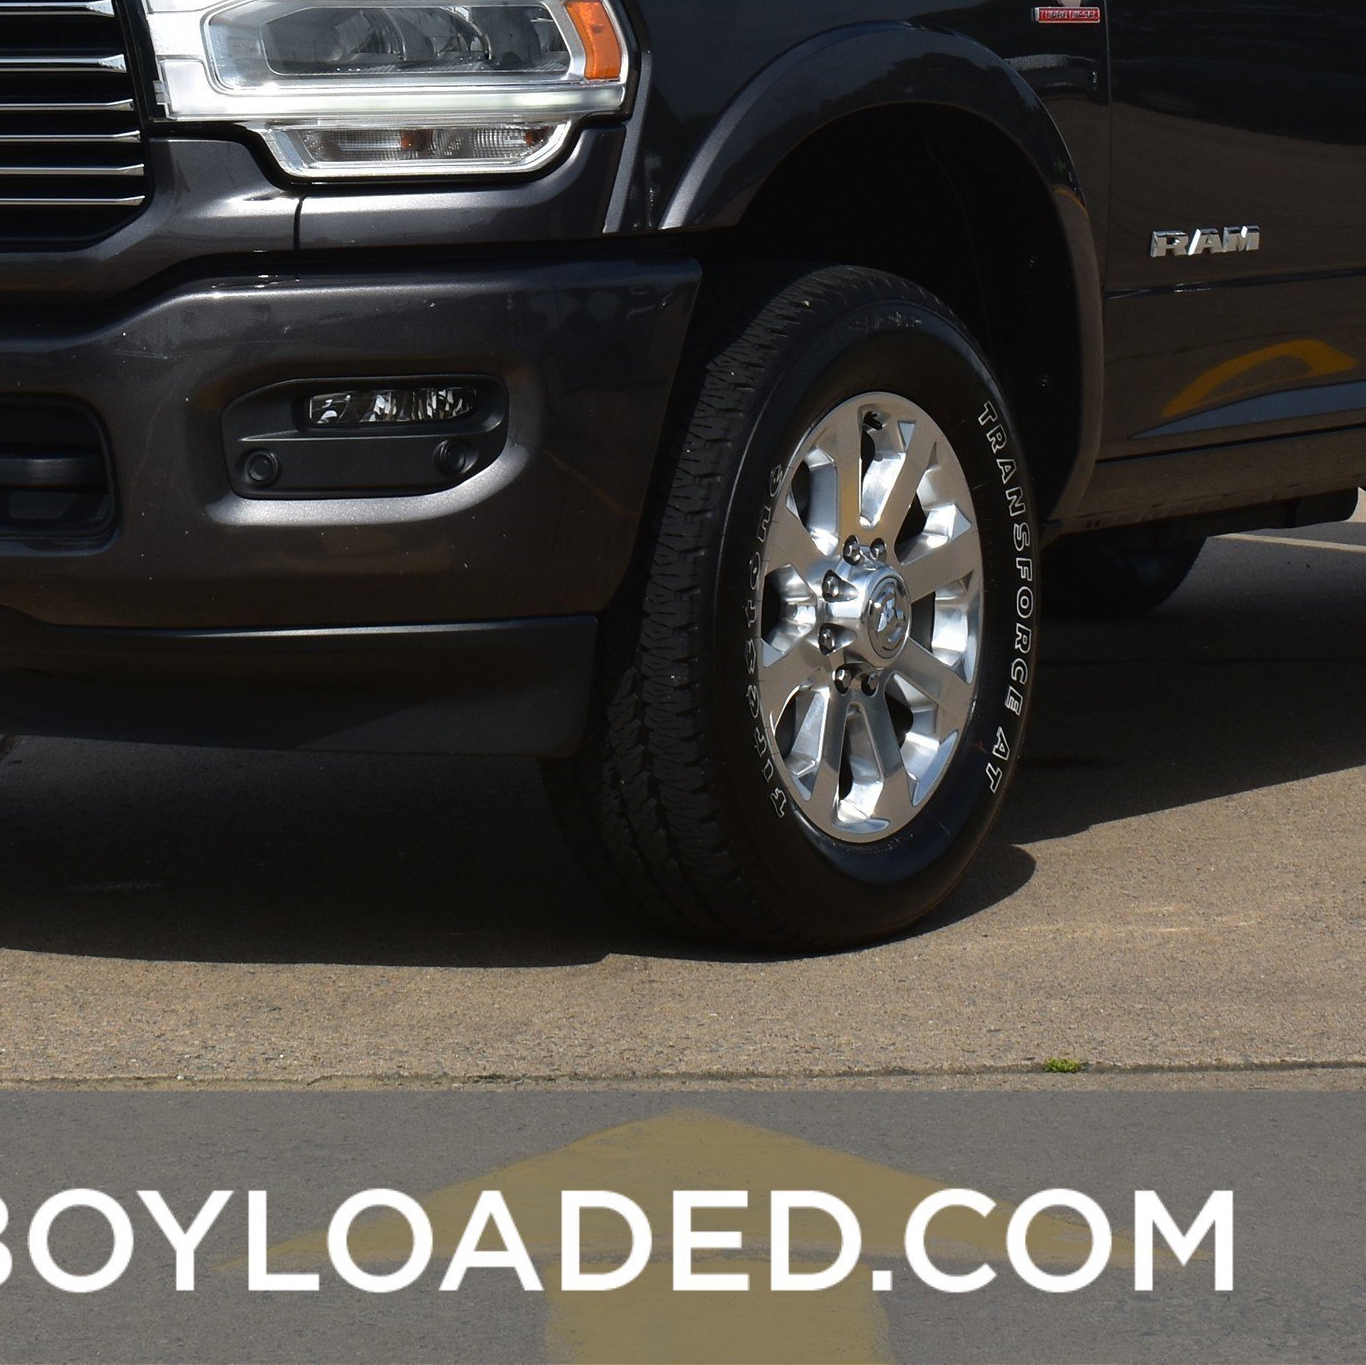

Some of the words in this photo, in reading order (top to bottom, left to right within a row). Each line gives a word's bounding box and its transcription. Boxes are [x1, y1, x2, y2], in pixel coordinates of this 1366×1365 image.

[1150, 225, 1260, 257] RAM
[977, 401, 1034, 717] TRANSFORCE
[985, 726, 1012, 794] AT
